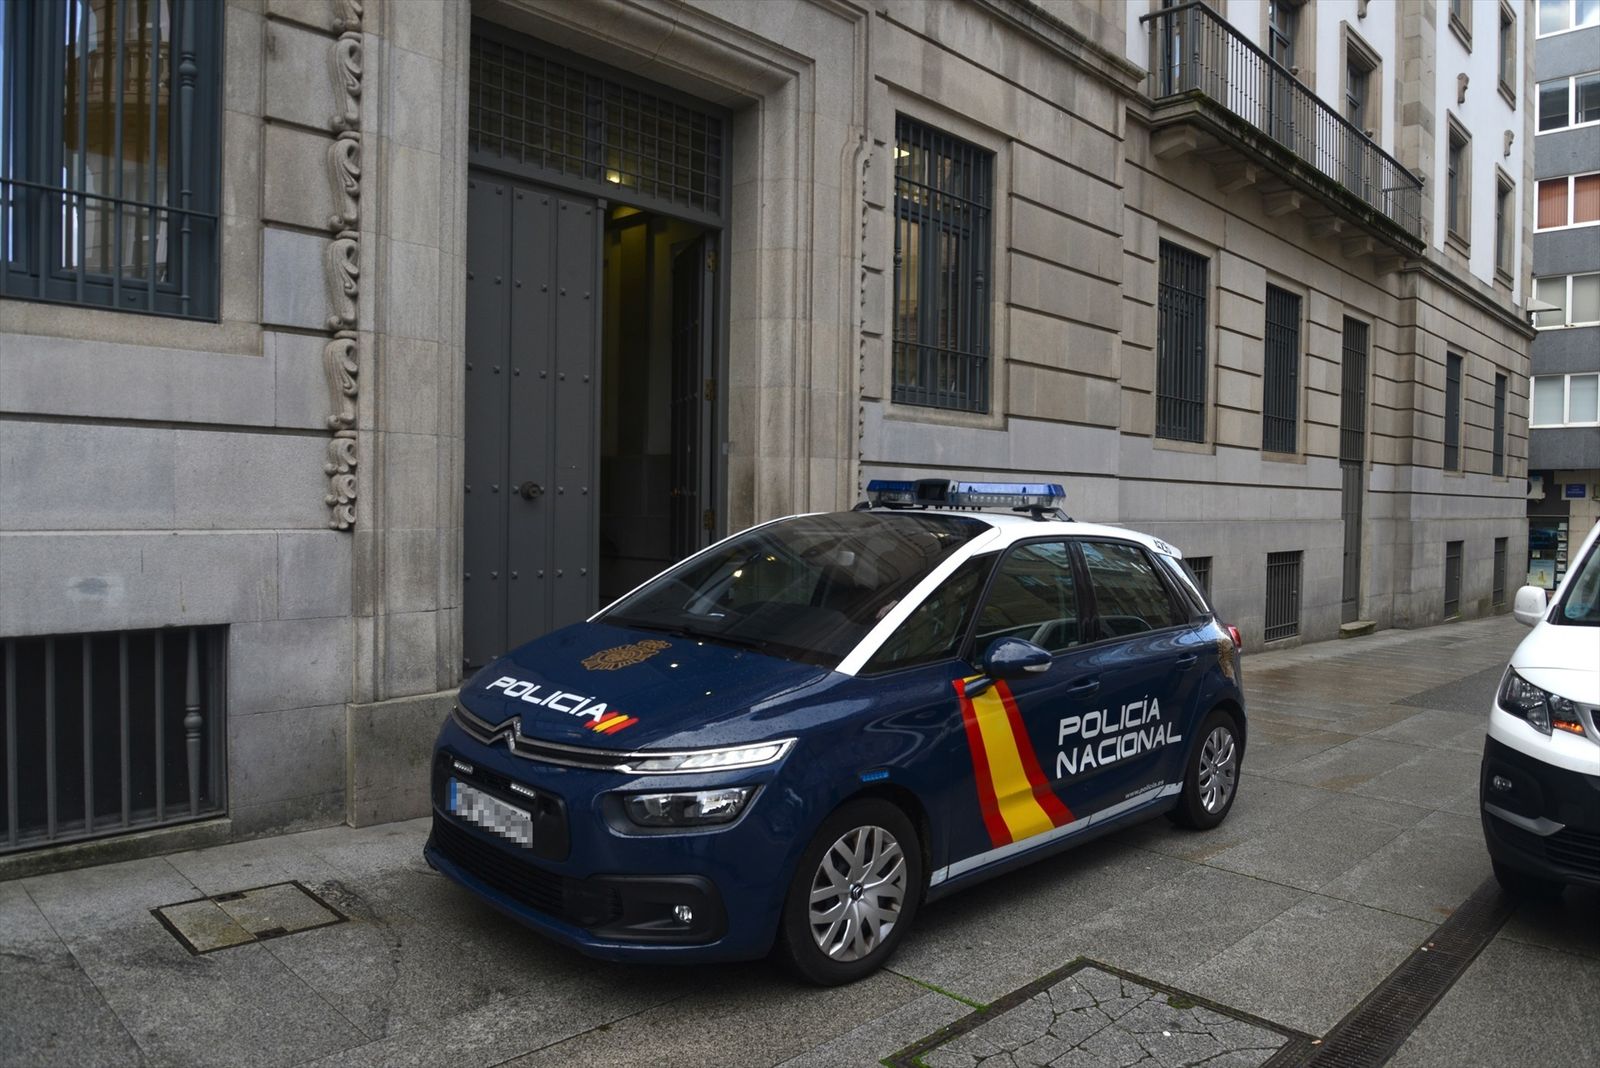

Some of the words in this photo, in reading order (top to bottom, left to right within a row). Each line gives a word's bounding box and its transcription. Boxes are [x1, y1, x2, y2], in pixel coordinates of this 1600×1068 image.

[486, 676, 608, 722] POLICÍA
[1058, 694, 1161, 746] POLICÍA
[1056, 721, 1182, 779] NACIONAL
